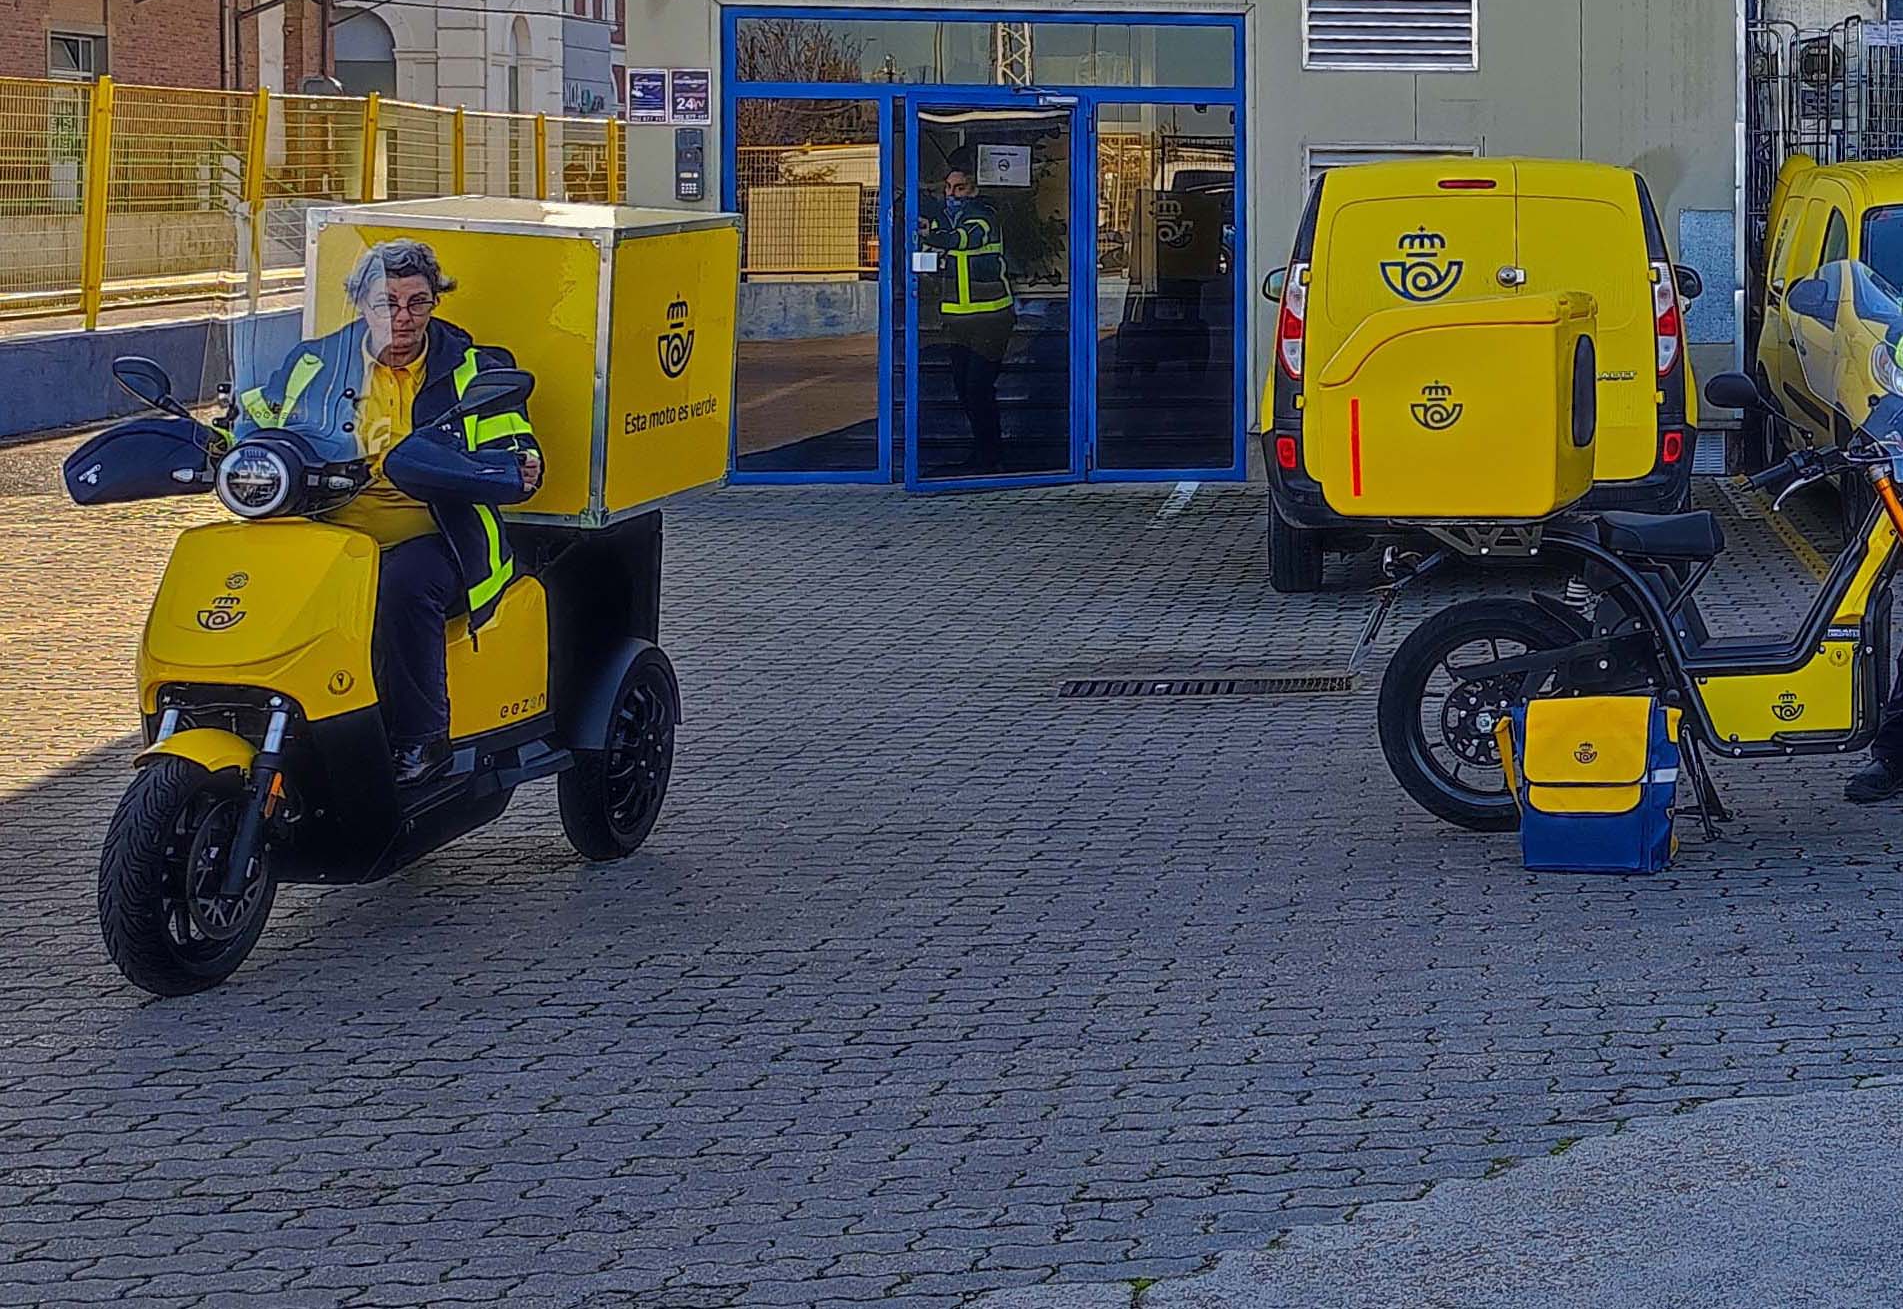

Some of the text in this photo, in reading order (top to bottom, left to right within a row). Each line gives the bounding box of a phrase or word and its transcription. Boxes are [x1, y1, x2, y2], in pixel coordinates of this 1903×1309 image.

[624, 393, 717, 435] Esta moto es verde
